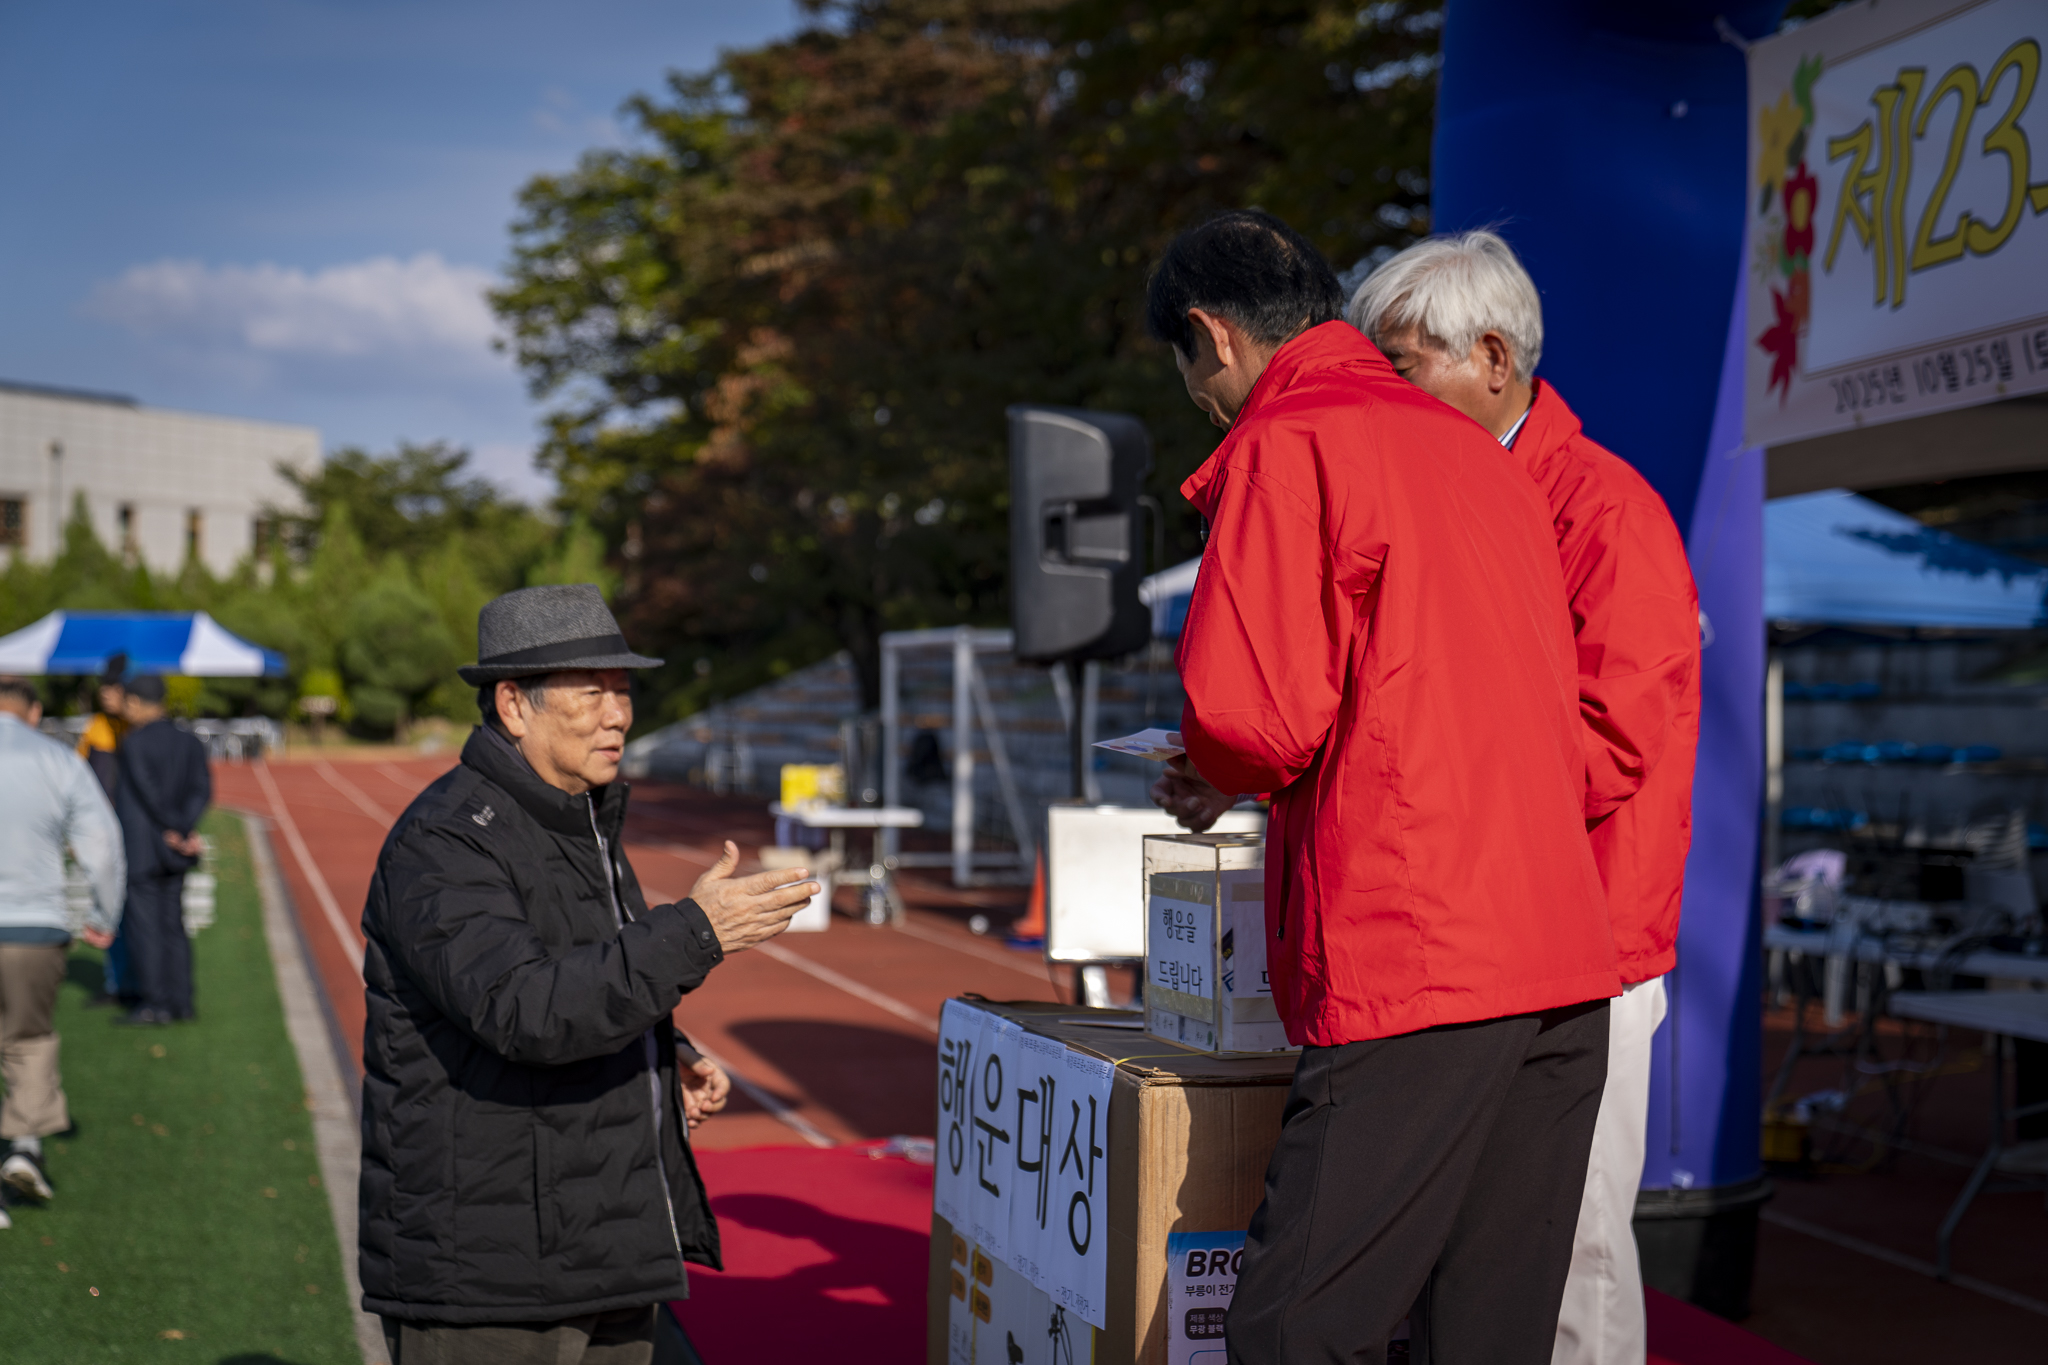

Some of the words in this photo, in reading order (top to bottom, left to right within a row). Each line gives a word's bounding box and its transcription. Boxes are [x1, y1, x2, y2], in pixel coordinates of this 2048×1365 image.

[1822, 36, 2048, 310] 제23
[1162, 908, 1197, 944] 행운을
[1157, 960, 1203, 997] 드립니다
[939, 1037, 1103, 1256] 행운대상
[1185, 1285, 1215, 1297] 부릉이
[1189, 1313, 1205, 1323] 제품
[1208, 1313, 1224, 1323] 색상
[1189, 1324, 1206, 1334] 무광
[1208, 1324, 1224, 1334] 블랙
